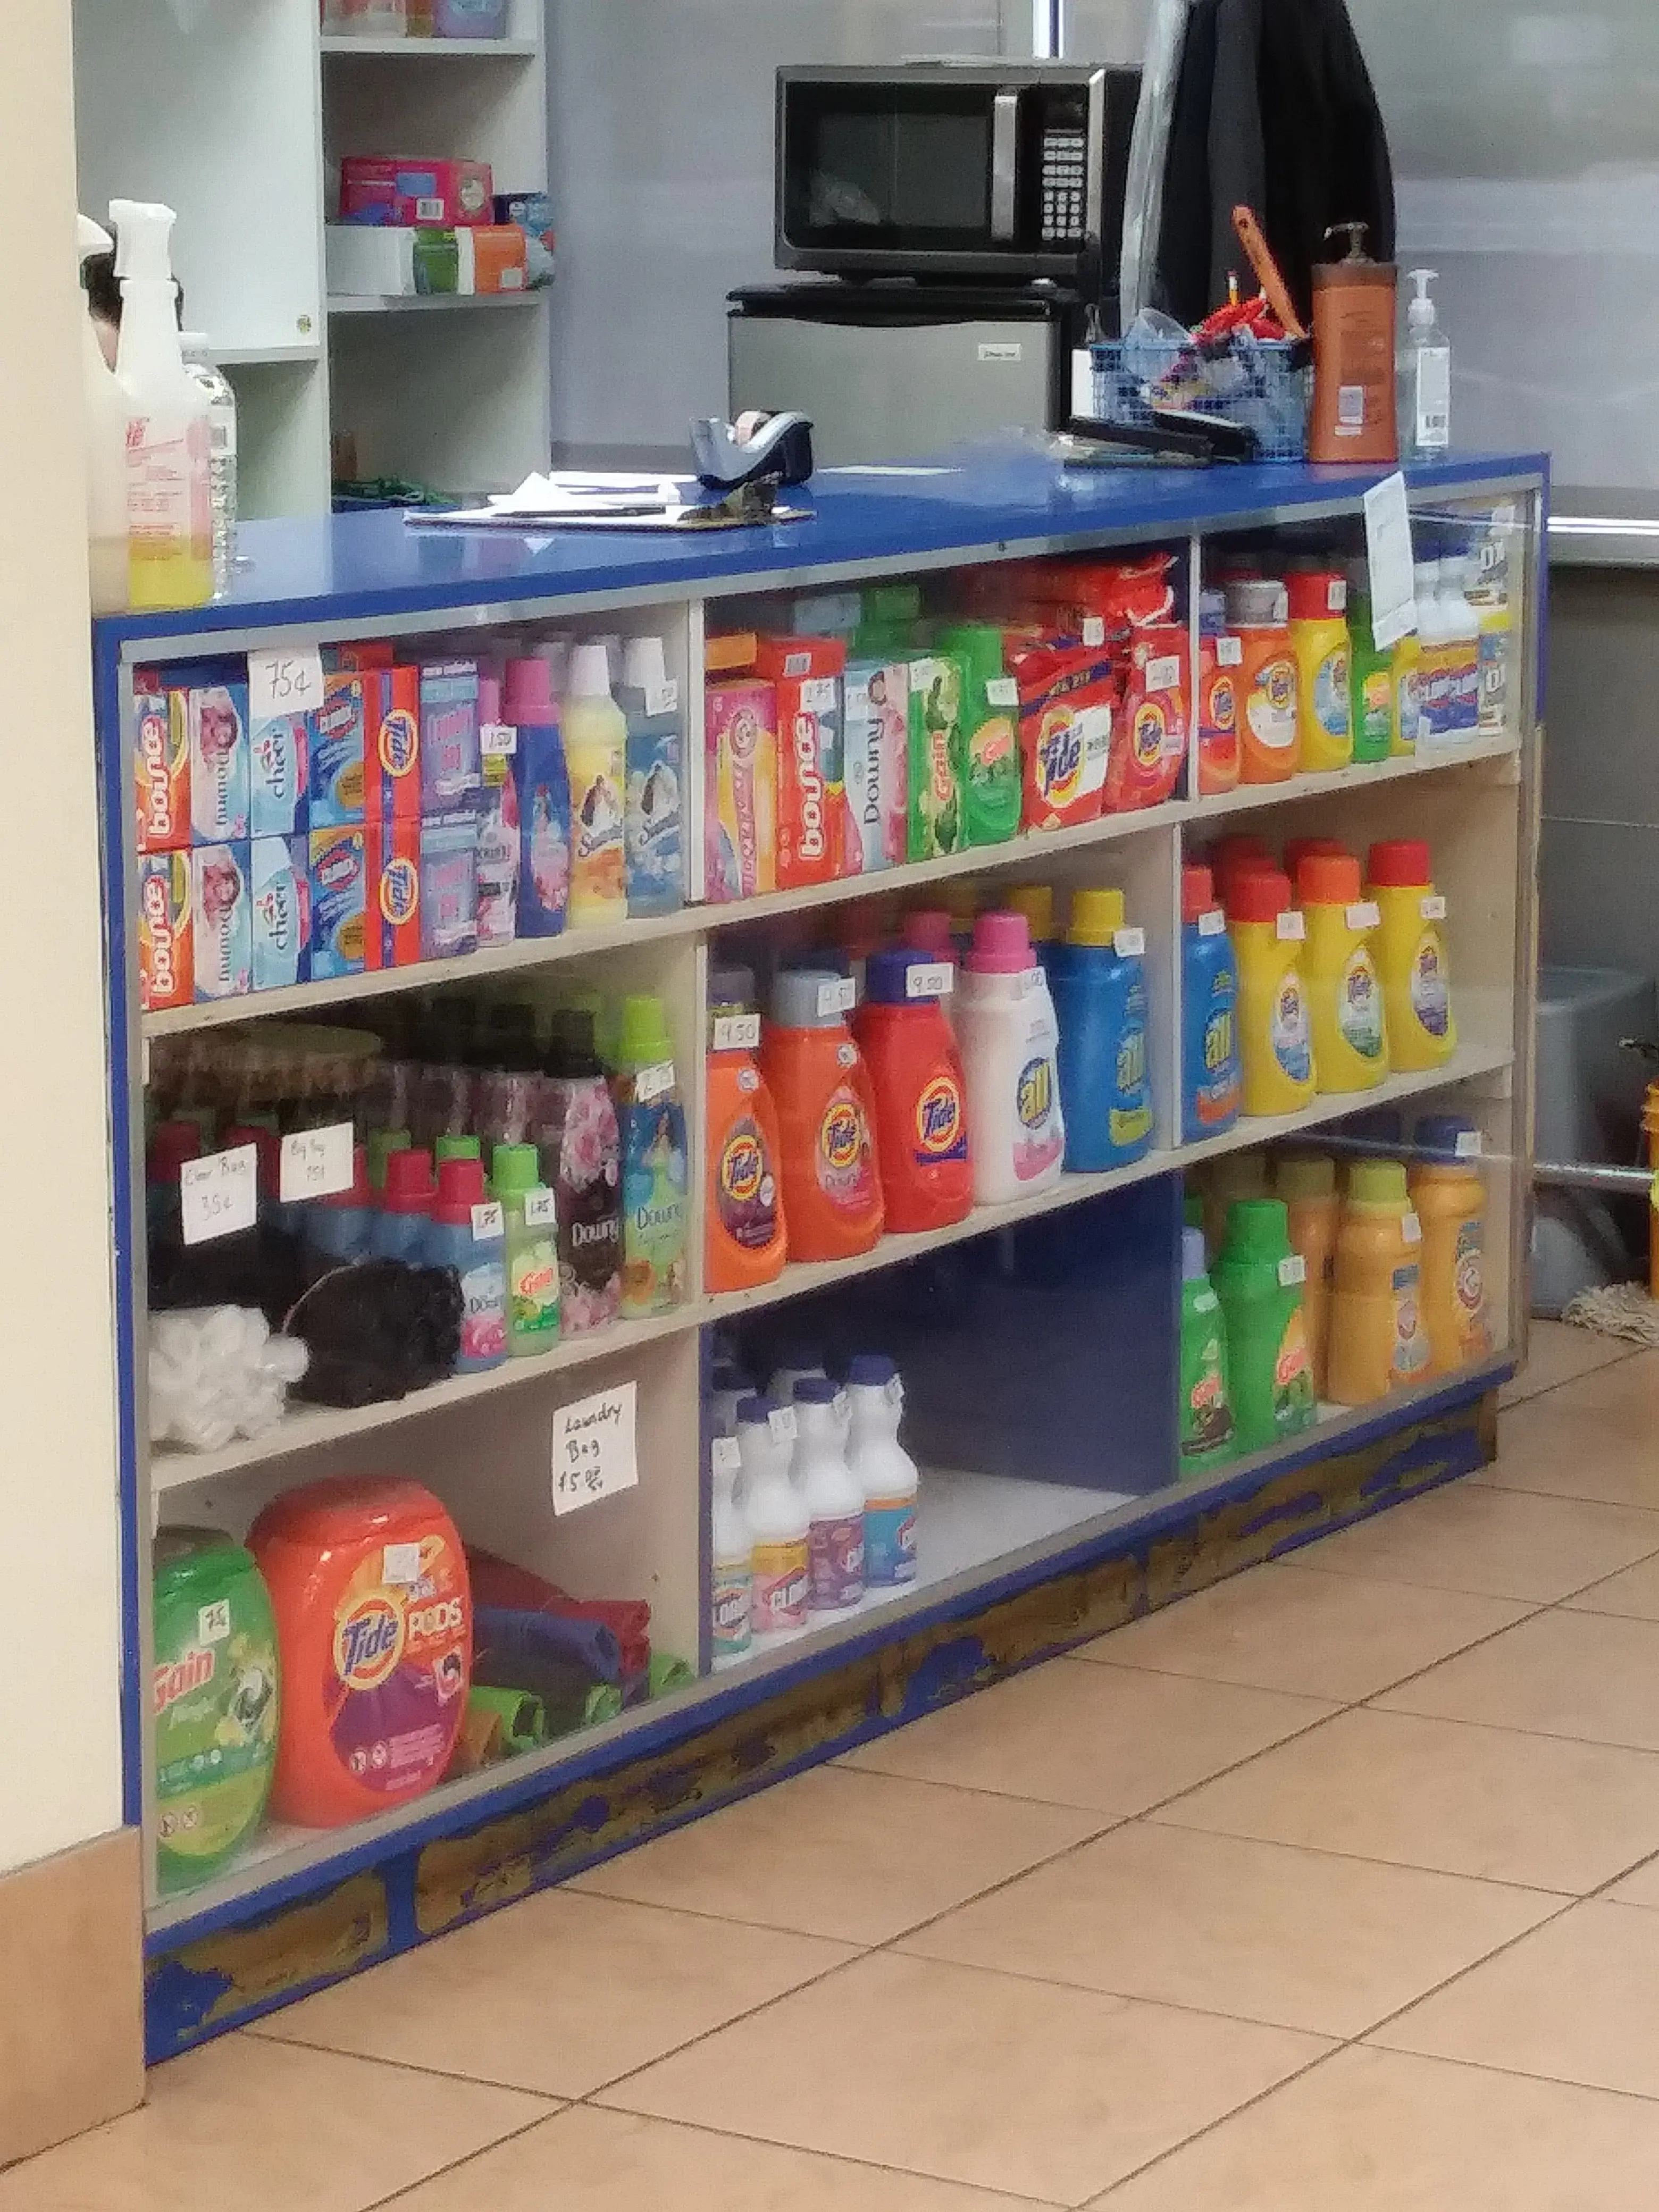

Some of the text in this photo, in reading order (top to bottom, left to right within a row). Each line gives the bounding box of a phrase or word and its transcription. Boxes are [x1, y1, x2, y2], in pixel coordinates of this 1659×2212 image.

[265, 659, 312, 700] 75¢
[141, 716, 171, 836] bounce
[795, 713, 823, 859] bounce
[863, 718, 884, 824] Downy
[142, 875, 174, 995] bounce
[564, 1402, 623, 1434] Laundry
[342, 1614, 399, 1675] Tide
